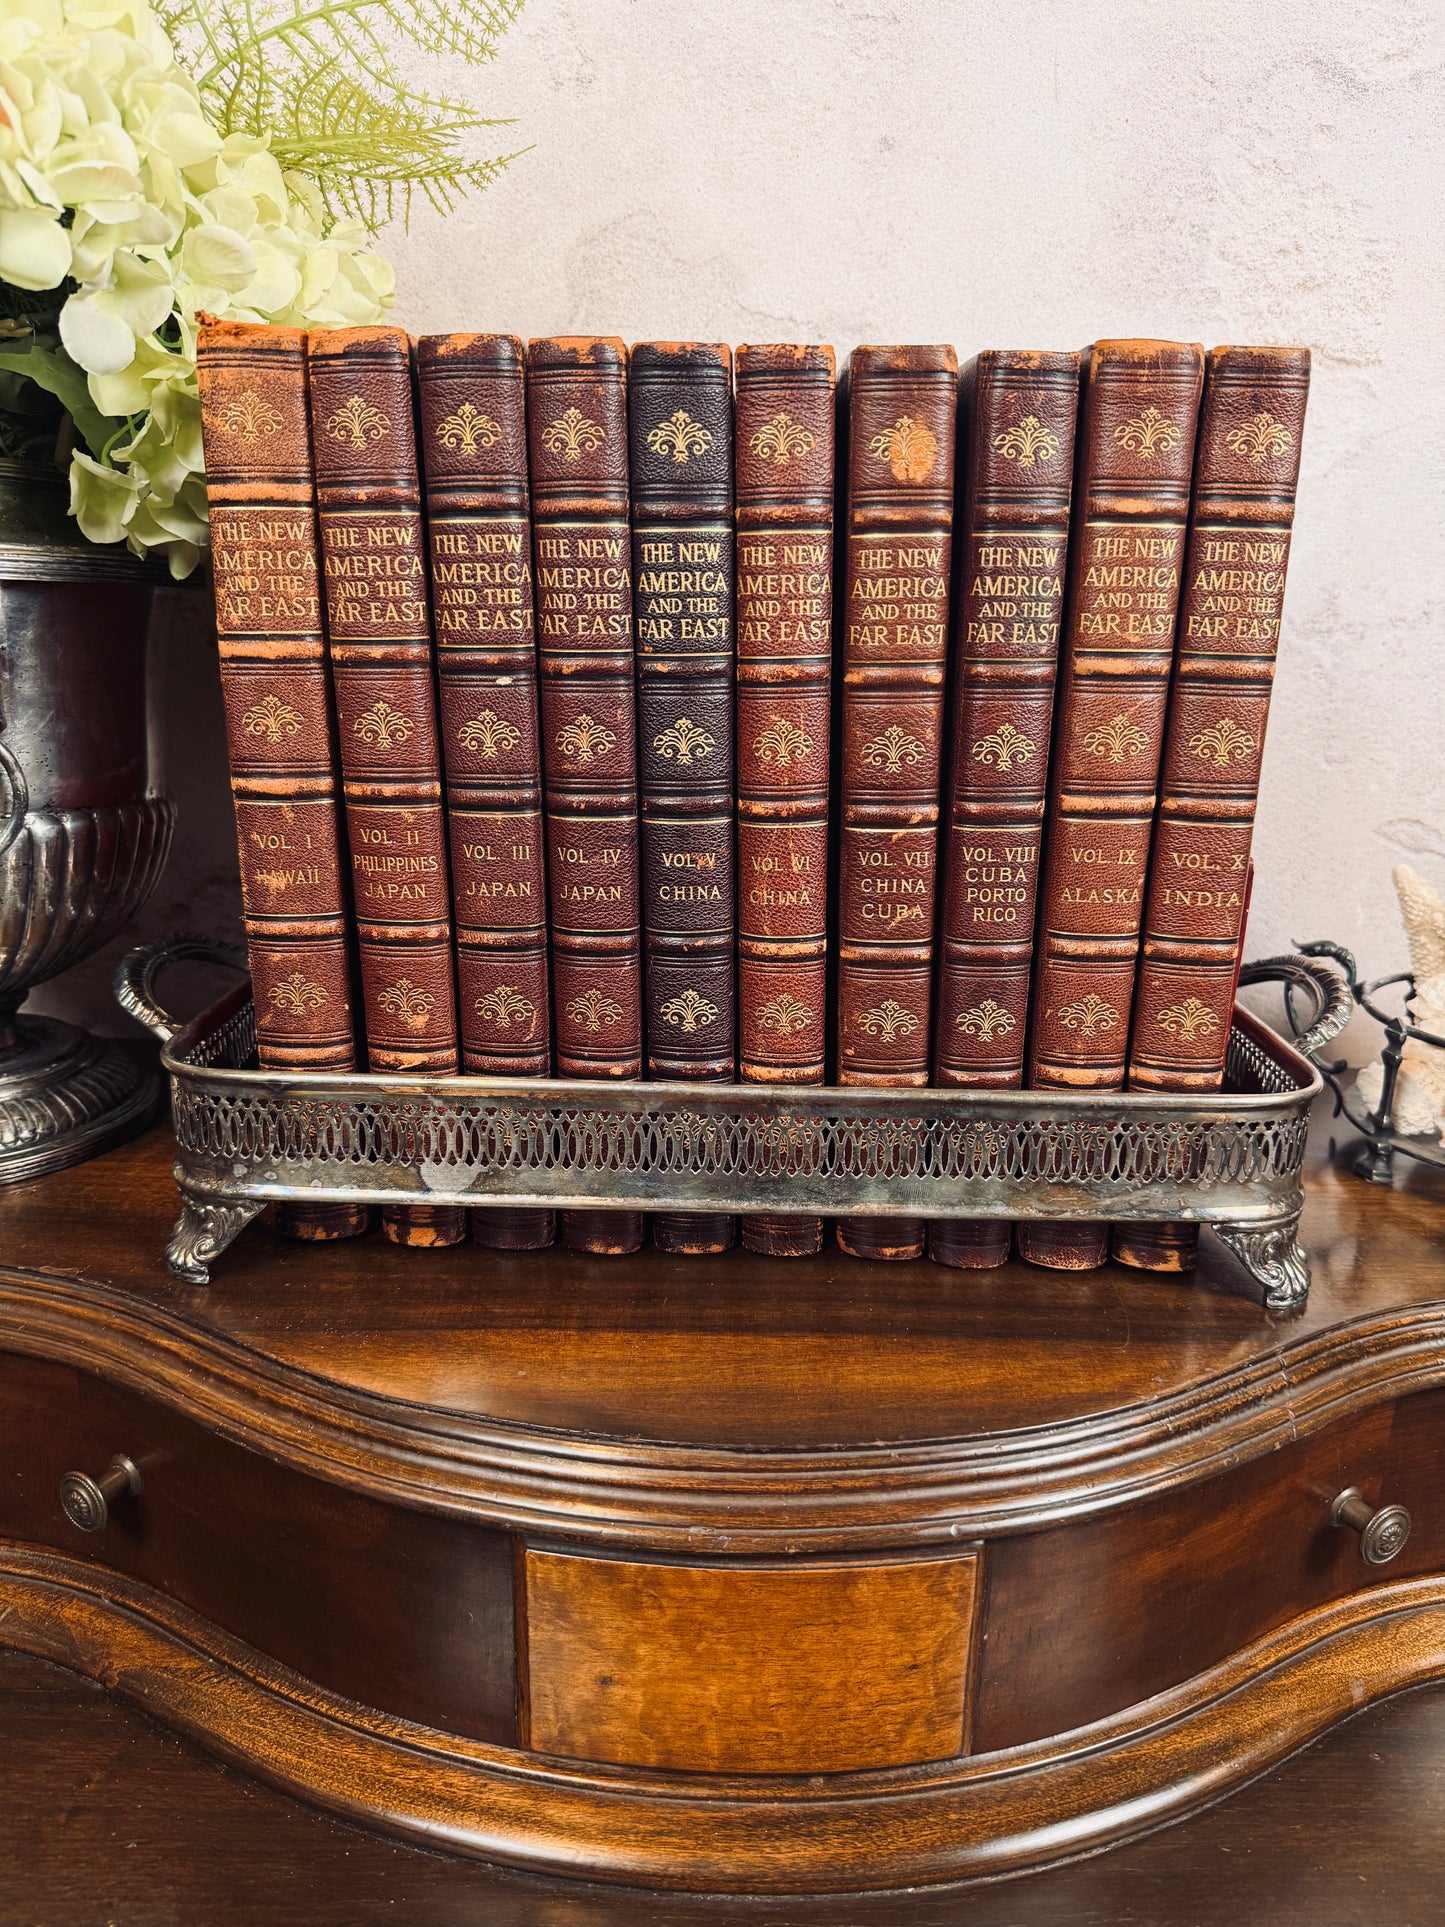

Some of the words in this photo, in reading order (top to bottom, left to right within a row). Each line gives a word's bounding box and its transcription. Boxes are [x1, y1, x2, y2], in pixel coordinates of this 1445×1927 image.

[218, 522, 251, 541] THE
[260, 522, 307, 541] NEW
[326, 528, 362, 546] THE
[367, 527, 414, 546] NEW
[435, 535, 468, 554] THE
[477, 534, 523, 553] NEW
[539, 539, 571, 558] THE
[578, 539, 623, 558] NEW
[1094, 538, 1130, 558] THE
[1135, 538, 1178, 558] NEW
[1204, 542, 1239, 562] THE
[1244, 542, 1286, 563] NEW
[641, 543, 674, 563] THE
[679, 543, 720, 563] NEW
[742, 547, 776, 566] THE
[782, 545, 828, 565] NEW
[859, 549, 893, 569] THE
[898, 549, 942, 568] NEW
[978, 548, 1013, 568] THE
[1017, 548, 1059, 567] NEW
[325, 556, 424, 576] AMERICA
[224, 576, 259, 591] AND
[266, 575, 304, 591] THE
[638, 571, 728, 593] AMERICA
[1084, 567, 1178, 587] AMERICA
[1193, 570, 1285, 592] AMERICA
[336, 581, 369, 597] AND
[375, 581, 413, 596] THE
[852, 577, 947, 598] AMERICA
[970, 576, 1062, 597] AMERICA
[441, 589, 477, 604] AND
[483, 588, 522, 604] THE
[543, 594, 577, 609] AND
[583, 594, 621, 609] THE
[1093, 593, 1132, 608] AND
[1137, 594, 1169, 609] THE
[261, 597, 319, 616] EAST
[370, 602, 426, 621] EAST
[648, 598, 682, 614] AND
[687, 598, 719, 613] THE
[746, 601, 780, 617] AND
[787, 600, 822, 615] THE
[861, 604, 899, 620] AND
[903, 604, 937, 619] THE
[978, 602, 1016, 618] AND
[1020, 602, 1053, 618] THE
[1202, 597, 1240, 612] AND
[1246, 598, 1275, 613] THE
[478, 609, 534, 630] EAST
[577, 615, 631, 635] EAST
[638, 618, 673, 639] FAR
[682, 617, 730, 639] EAST
[1079, 613, 1120, 634] FAR
[1128, 614, 1175, 635] EAST
[1186, 616, 1228, 637] FAR
[1236, 617, 1280, 639] EAST
[780, 620, 831, 642] EAST
[850, 625, 889, 646] FAR
[897, 624, 946, 645] EAST
[967, 623, 1005, 644] FAR
[1012, 623, 1059, 644] EAST
[306, 835, 313, 849] I
[407, 830, 420, 845] II
[463, 844, 501, 860] VOL.
[512, 845, 531, 860] III
[558, 847, 593, 864] VOL.
[602, 849, 622, 864] IV
[859, 852, 897, 866] VOL.
[904, 852, 930, 866] VII
[963, 847, 1000, 862] VOL.
[1005, 847, 1036, 862] VIII
[1117, 849, 1136, 864] IX
[354, 855, 439, 872] PHILIPPINES
[795, 856, 810, 871] VI
[1173, 853, 1220, 869] VOL.
[1231, 855, 1245, 869] X
[965, 868, 1027, 882] CUBA
[365, 883, 426, 899] JAPAN
[466, 881, 531, 897] JAPAN
[560, 885, 622, 900] JAPAN
[659, 885, 722, 900] CHINA
[861, 879, 928, 893] CHINA
[750, 889, 811, 904] CHINA
[967, 888, 1026, 902] PORTO
[1061, 887, 1140, 903] ALASKA
[1164, 889, 1242, 907] INDIA
[862, 904, 925, 918] CUBA
[973, 908, 1016, 921] RICO
